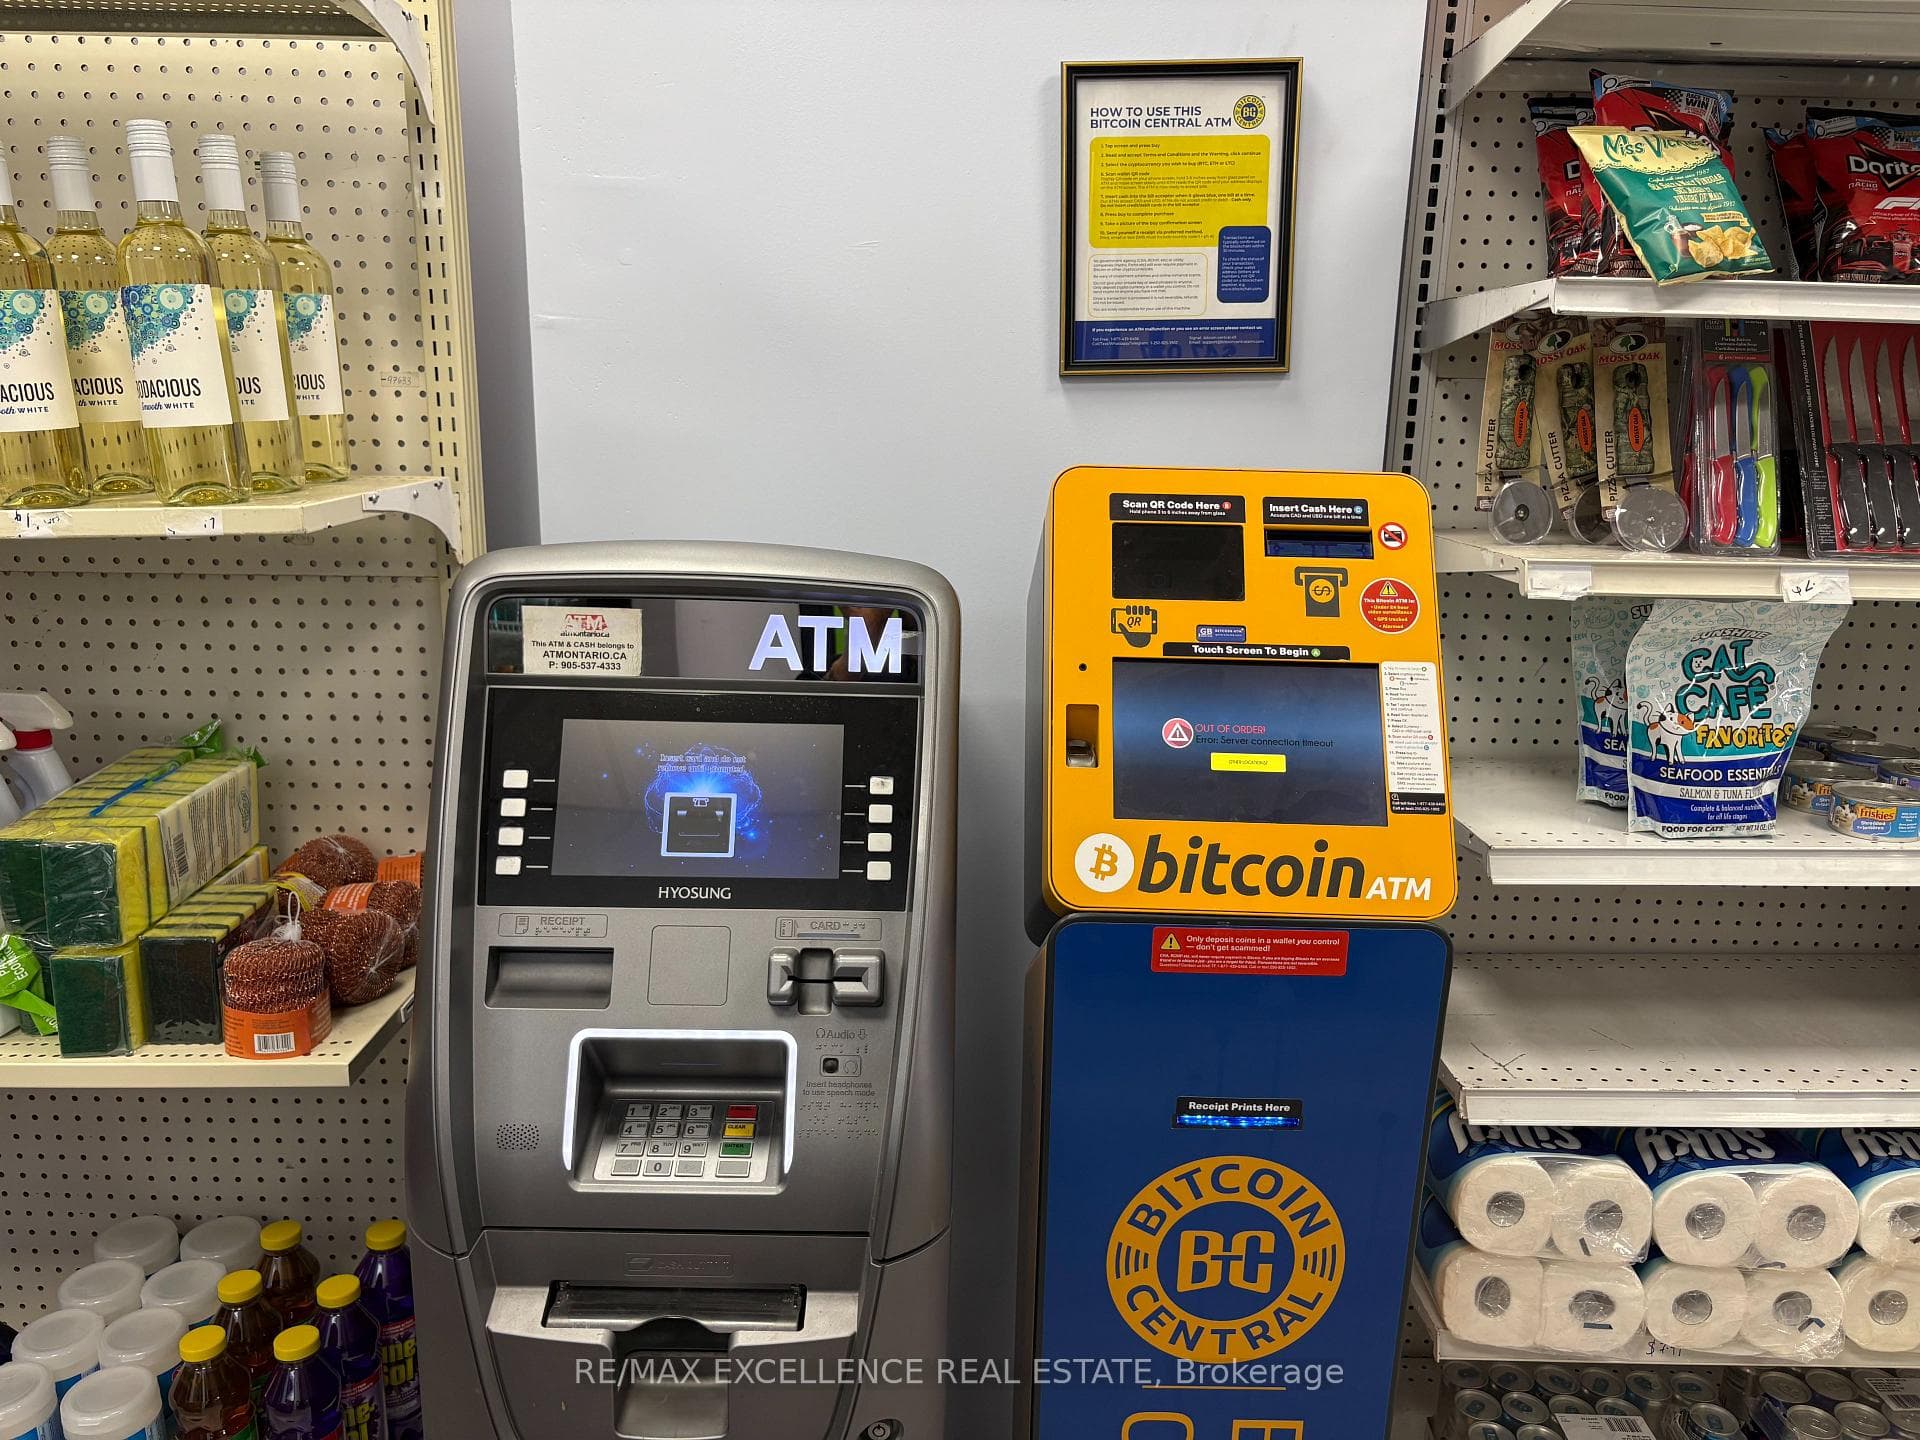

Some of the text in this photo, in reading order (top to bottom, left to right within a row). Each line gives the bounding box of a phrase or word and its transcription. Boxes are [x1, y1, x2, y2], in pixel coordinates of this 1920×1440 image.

[1090, 106, 1201, 117] HOW TO USE THIS
[1090, 117, 1232, 129] BITCOIN CENTRAL ATM
[1566, 342, 1587, 357] OAK
[1598, 352, 1661, 365] MOSSY OAK
[17, 406, 49, 414] WHITE
[1485, 418, 1497, 459] CUTTER
[1548, 431, 1564, 470] CUTTER
[1605, 430, 1615, 470] CUTTER
[1122, 500, 1220, 510] Scan QR Code Here
[1269, 503, 1353, 514] Insert Cash Here
[1126, 616, 1142, 627] QR
[1690, 627, 1772, 642] SUNSHINE
[597, 642, 625, 651] belongs
[748, 614, 902, 673] ATM
[543, 650, 627, 660] ATMONTARIO.CA
[1191, 644, 1309, 658] Touch Screen To Begin
[548, 661, 621, 670] P: 905-537-4333
[1675, 676, 1772, 720] CAFÉ
[1195, 723, 1266, 735] OUT OF ORDER!
[1196, 735, 1333, 748] Error: Server connection timeout
[1660, 767, 1722, 782] SEAFOOD
[1604, 791, 1626, 801] FOOD
[1680, 787, 1743, 799] SALMON & TUNA
[1860, 807, 1894, 820] Friskies
[1138, 834, 1431, 901] bitcoin ATM
[657, 886, 732, 900] HYOSUNG
[540, 916, 586, 926] RECEIPT
[809, 920, 841, 931] CARD
[1186, 935, 1204, 943] Only
[1205, 935, 1234, 944] deposit
[1235, 936, 1256, 944] coins
[1272, 937, 1296, 945] wallet
[1313, 938, 1340, 946] control
[1216, 944, 1229, 953] get
[826, 1029, 856, 1040] Audio
[828, 1081, 872, 1090] headphones
[629, 1107, 635, 1116] 1
[659, 1107, 667, 1116] 2
[690, 1107, 698, 1116] 3
[1189, 1101, 1291, 1114] Receipt Prints Here
[624, 1125, 633, 1134] 4
[655, 1125, 664, 1134] 5
[687, 1126, 695, 1135] 6
[619, 1144, 629, 1153] 7
[651, 1144, 660, 1153] 8
[683, 1144, 692, 1153] 9
[653, 1162, 662, 1172] 0
[1127, 1162, 1331, 1240] BITCOIN
[1126, 1284, 1324, 1357] CENTRAL
